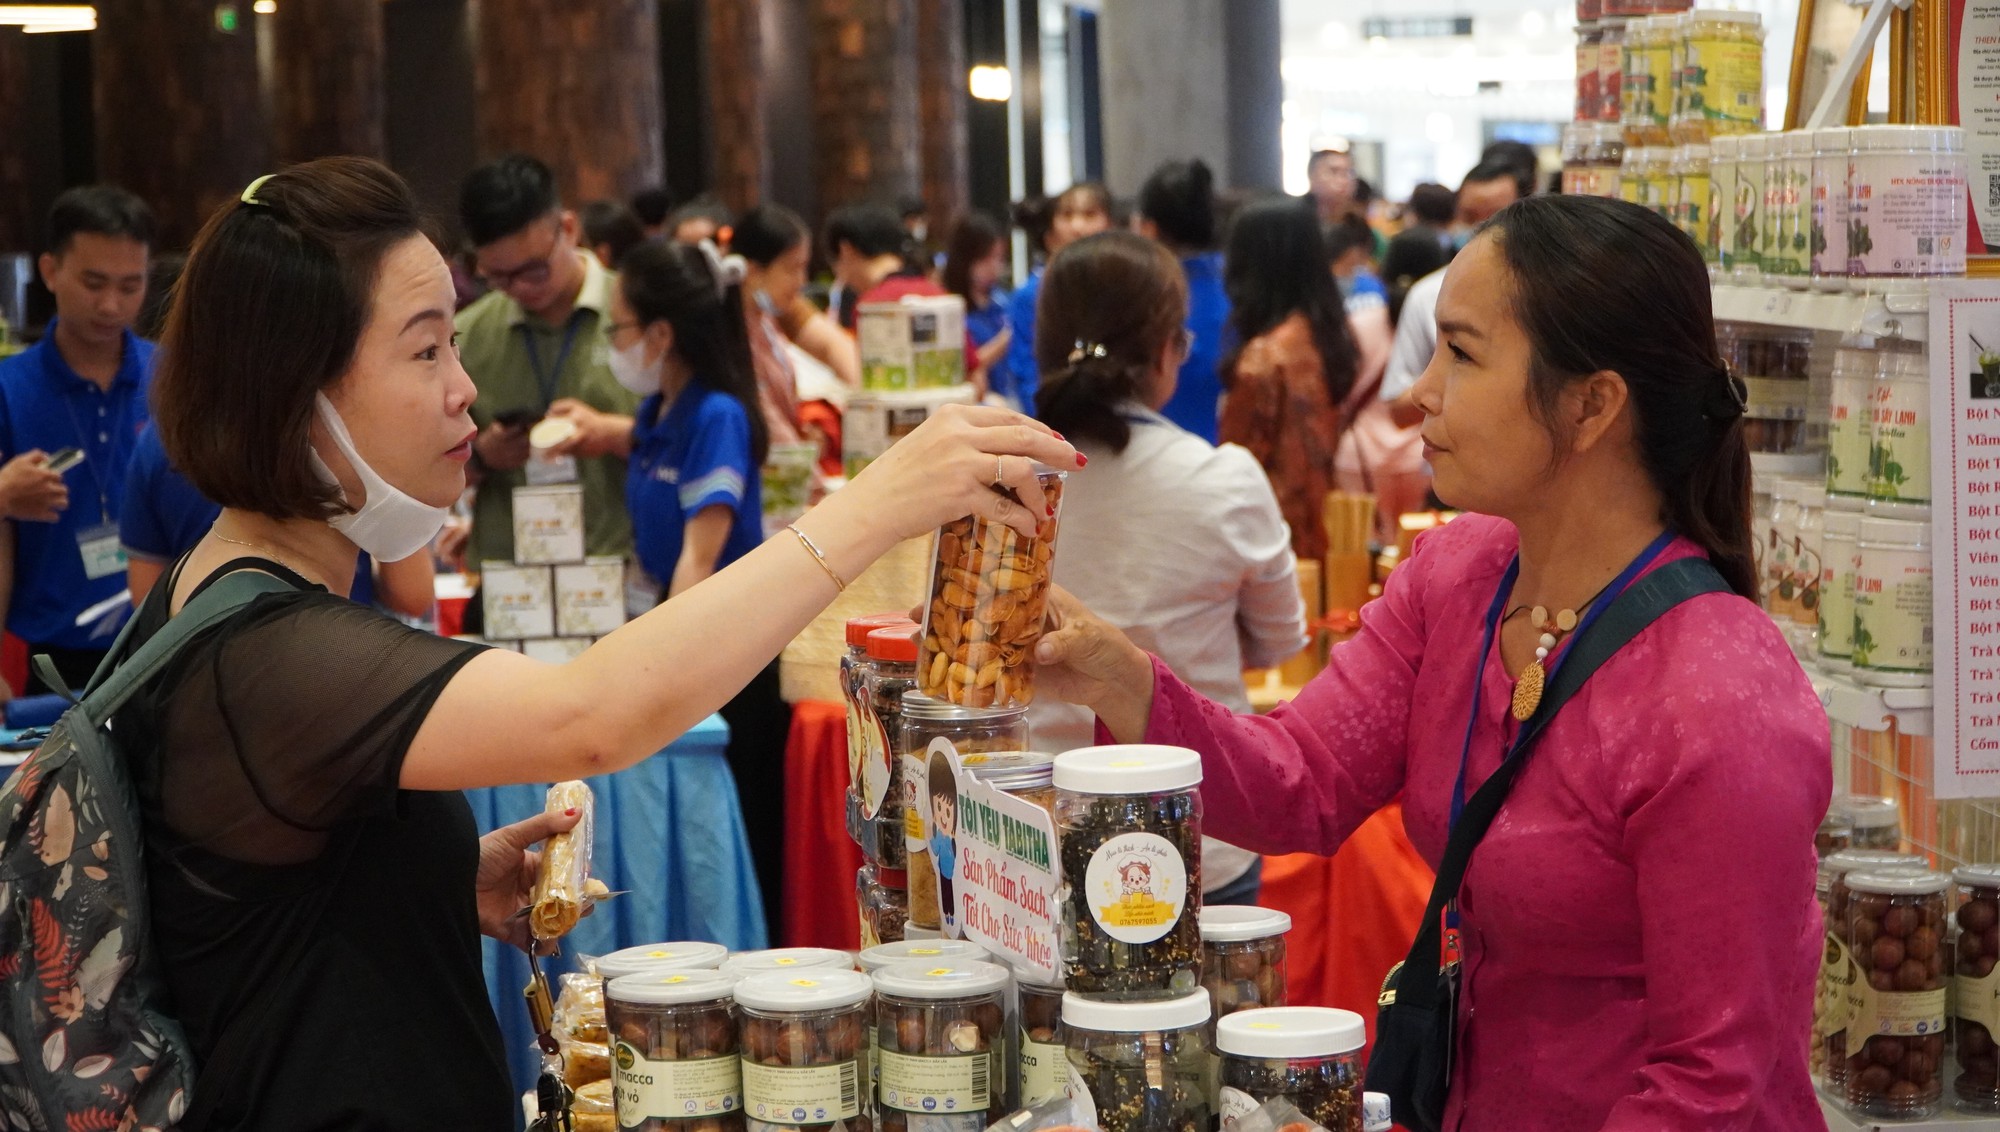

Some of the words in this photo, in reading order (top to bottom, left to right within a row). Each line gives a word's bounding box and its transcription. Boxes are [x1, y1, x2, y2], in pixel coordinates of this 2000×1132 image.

[1967, 408, 1989, 422] Bột
[1967, 434, 2000, 447] Mầm
[1968, 457, 1990, 472] Bột
[1968, 481, 1990, 496] Bột
[1968, 505, 1990, 520] Bột
[1969, 528, 1991, 543] Bột
[1969, 552, 1998, 564] Viên
[1969, 575, 1998, 587] Viên
[1970, 599, 1992, 613] Bột
[1970, 622, 1992, 636] Bột
[1969, 646, 1993, 657] Trà
[1969, 669, 1993, 680] Trà
[1969, 692, 1993, 704] Trà
[1969, 715, 1993, 727] Trà
[1970, 737, 1999, 750] Cốm
[958, 788, 979, 839] TÔI
[979, 799, 1001, 850] YÊU
[1002, 813, 1052, 874] TABITHA
[963, 846, 985, 887] Sản
[985, 858, 1018, 904] Phẩm
[1020, 875, 1050, 925] Sạch,
[1119, 918, 1158, 926] 0767597055
[962, 892, 981, 932] Tốt
[981, 902, 1002, 941] Cho
[1003, 913, 1024, 954] Sức
[1024, 925, 1053, 970] Khỏe
[620, 1071, 654, 1086] macca
